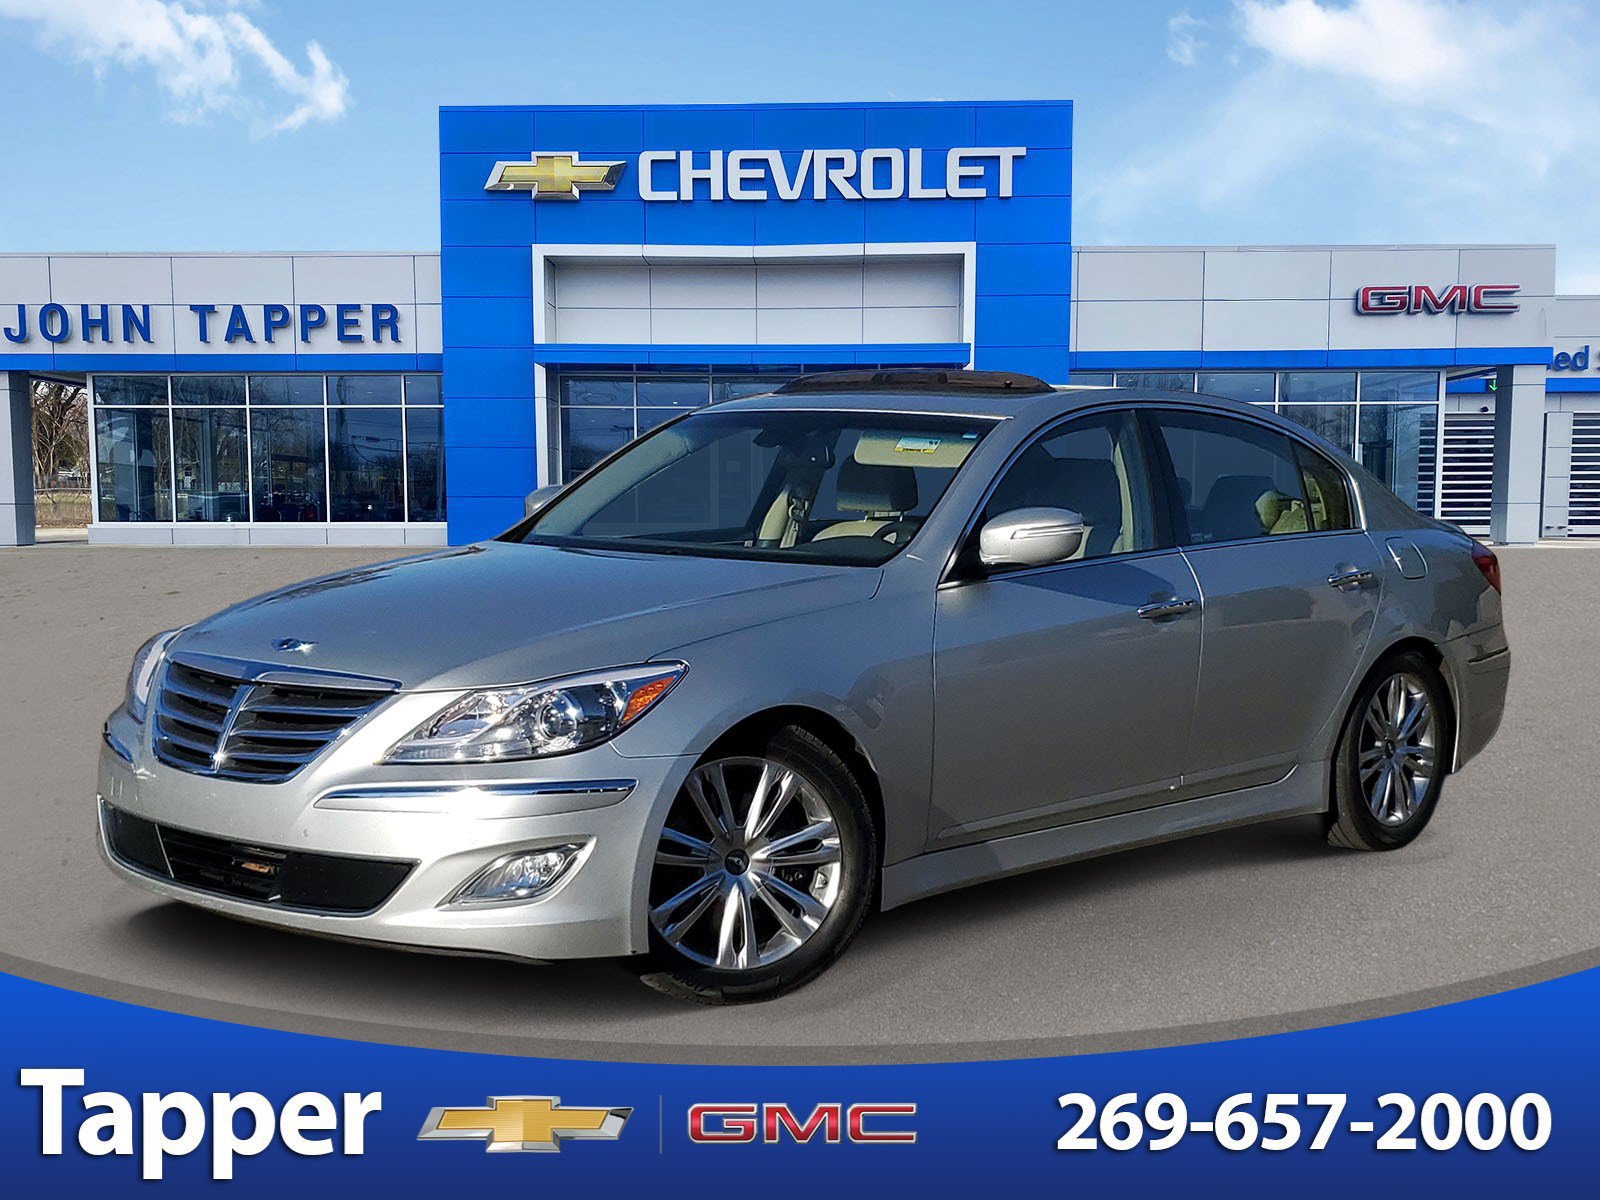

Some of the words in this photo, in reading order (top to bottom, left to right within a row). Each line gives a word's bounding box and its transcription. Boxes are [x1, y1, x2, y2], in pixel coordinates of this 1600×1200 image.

[638, 146, 1027, 201] CHEVROLET
[1357, 284, 1521, 314] GMC
[3, 303, 153, 343] JOHN
[190, 304, 401, 343] TAPPER
[1547, 345, 1590, 371] ed
